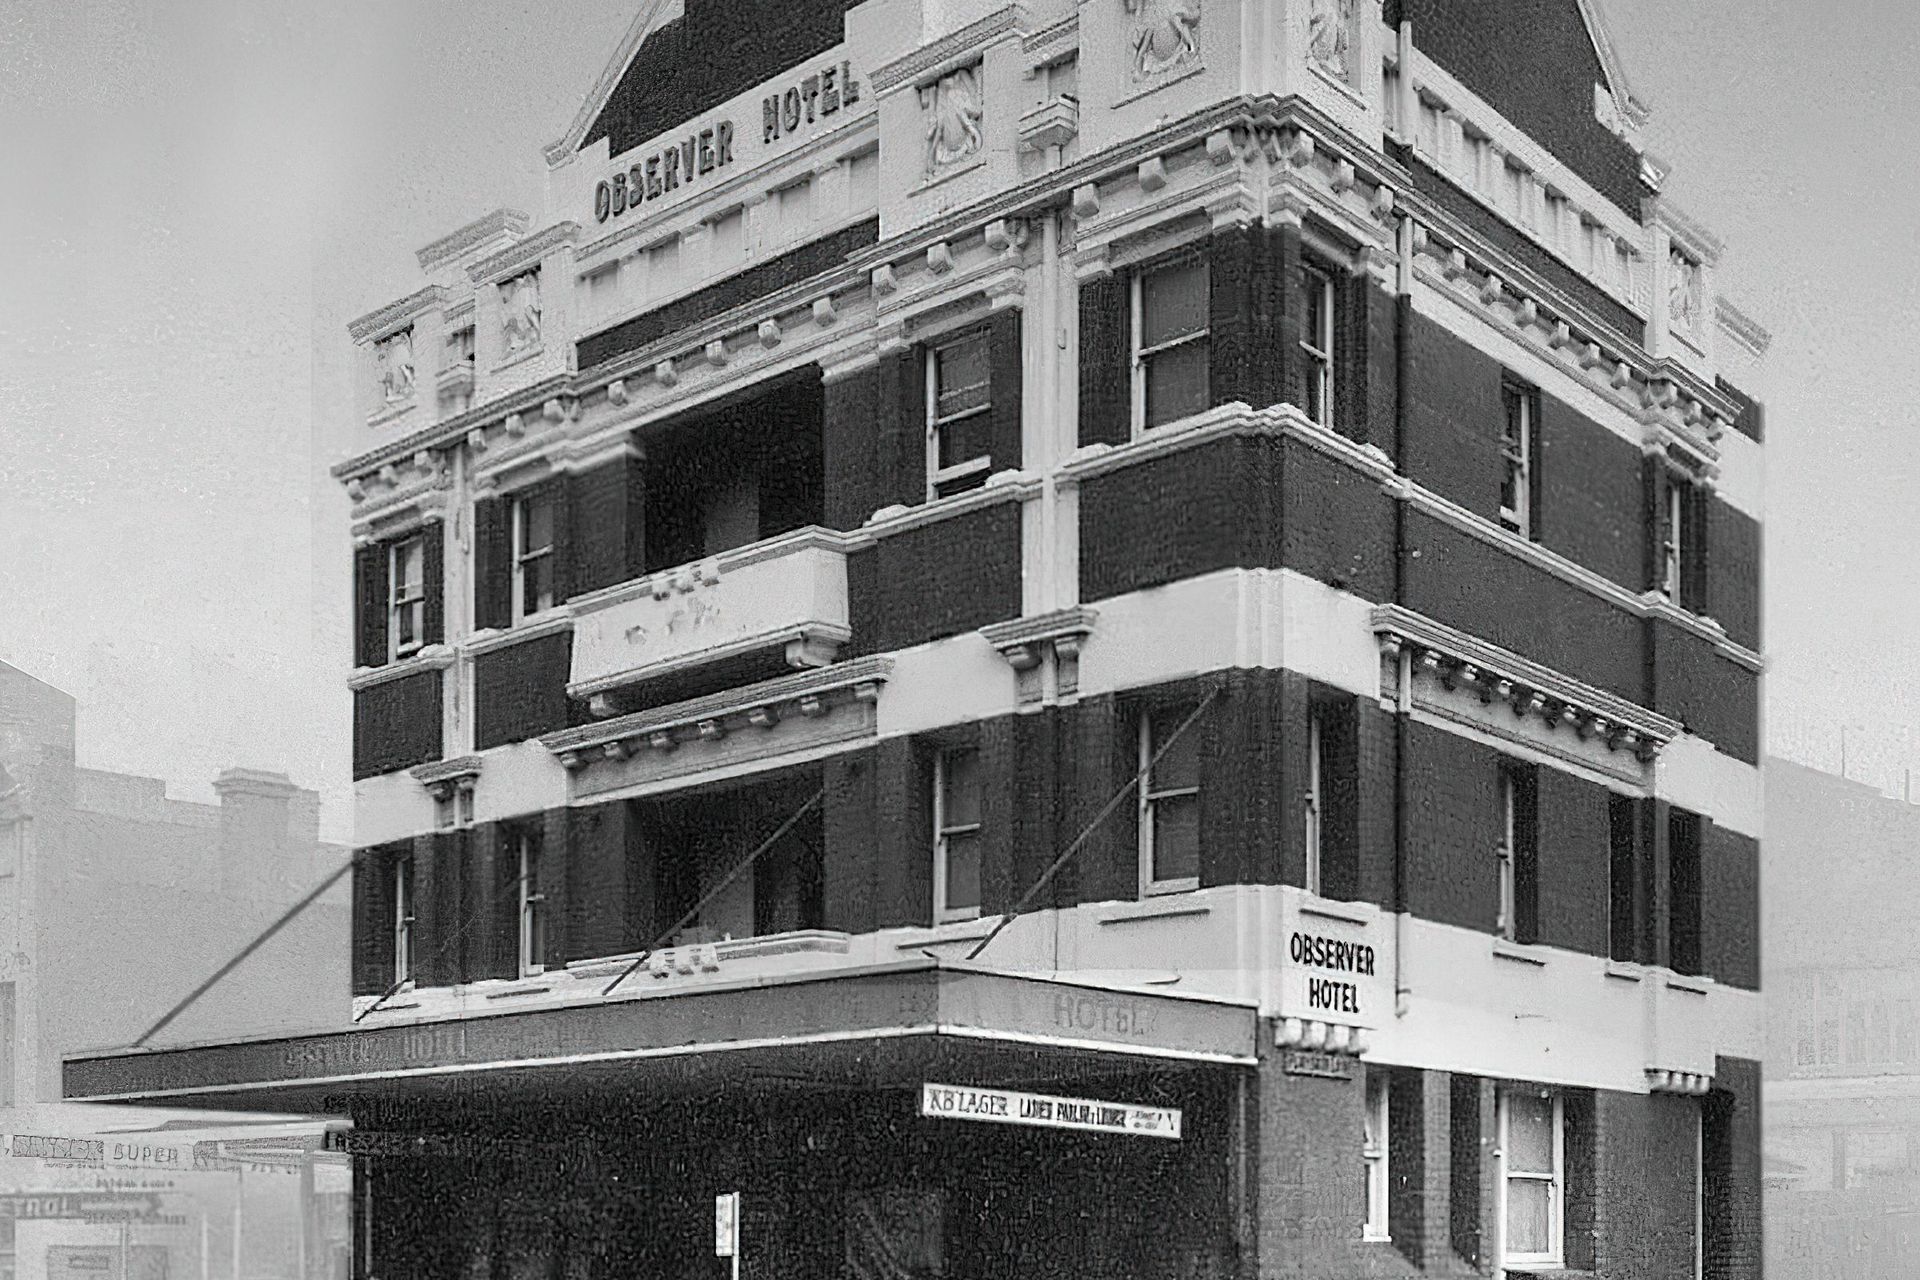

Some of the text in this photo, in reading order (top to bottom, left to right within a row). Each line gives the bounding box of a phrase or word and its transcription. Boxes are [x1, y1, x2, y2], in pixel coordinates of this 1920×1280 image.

[594, 59, 860, 224] OBSERVER HOTEL
[1290, 931, 1375, 976] OBSERVER
[1309, 977, 1360, 1013] HOTEL
[957, 1091, 1008, 1117] LAGER
[113, 1143, 178, 1163] SUPER
